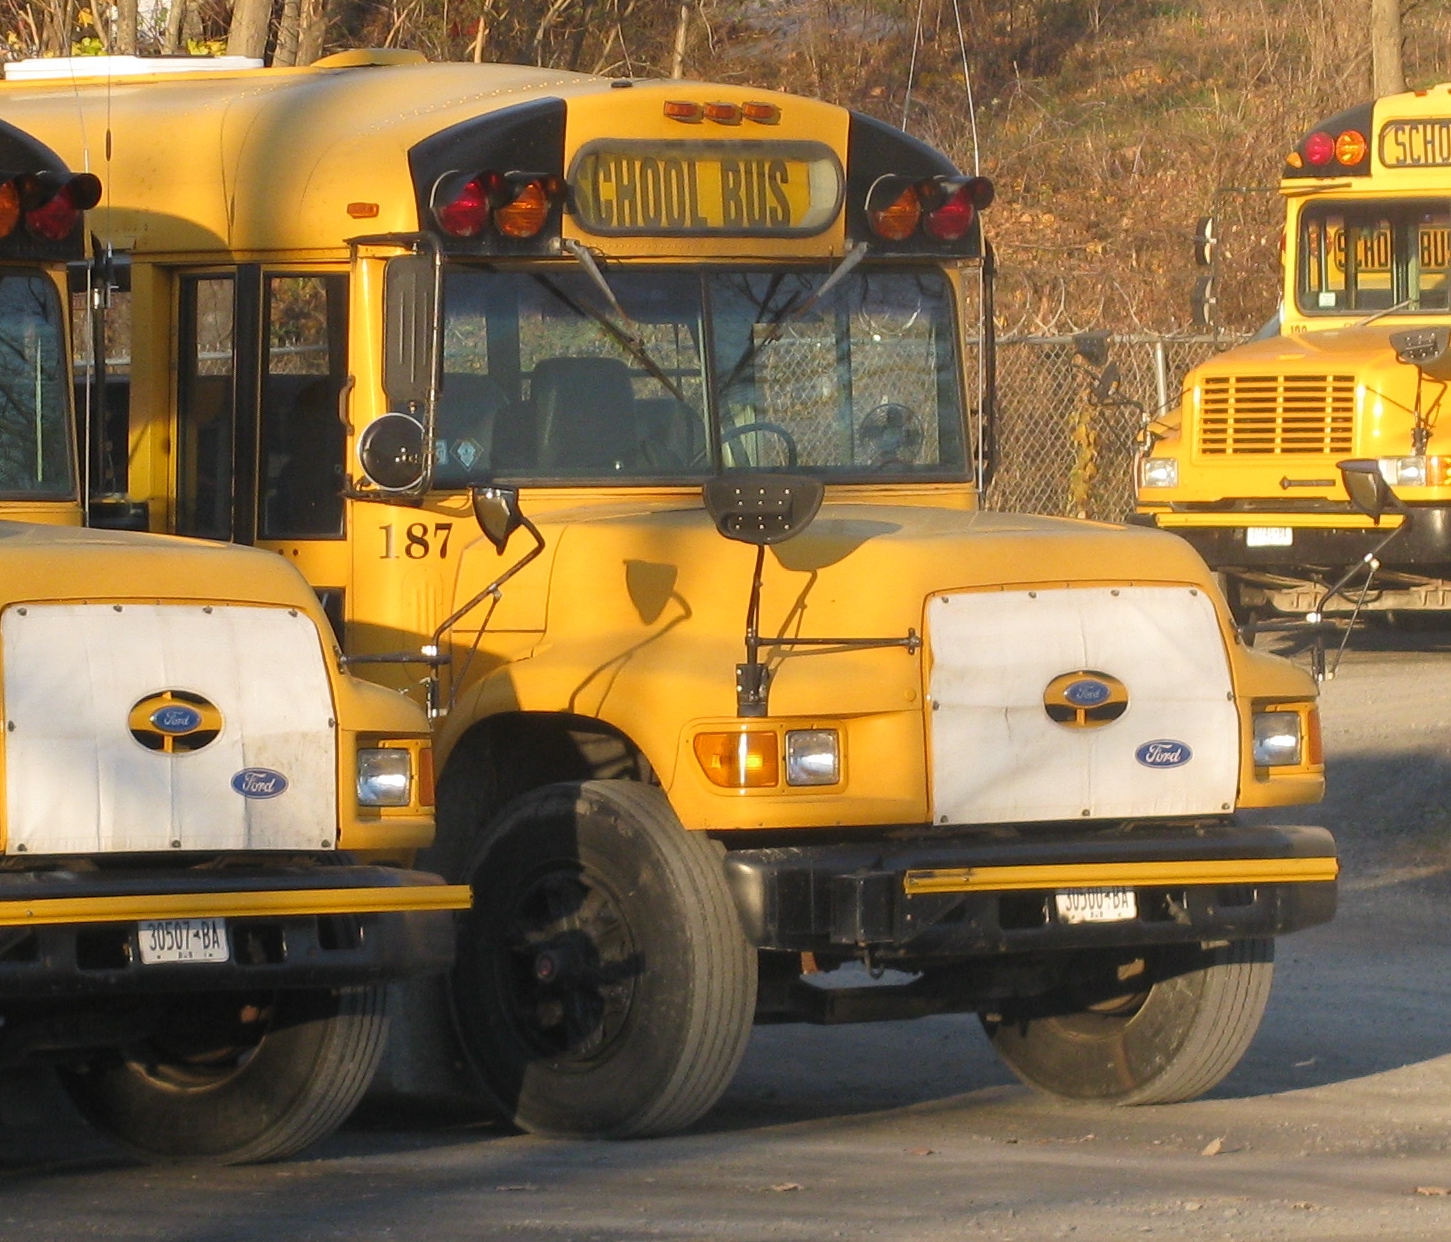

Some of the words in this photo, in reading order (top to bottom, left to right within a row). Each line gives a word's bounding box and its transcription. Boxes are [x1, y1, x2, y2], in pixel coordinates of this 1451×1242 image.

[720, 156, 791, 228] BUS
[378, 522, 453, 560] 187
[1076, 684, 1100, 699] Ford
[163, 711, 191, 727] Ford
[1146, 743, 1182, 764] Ford
[242, 771, 276, 794] Ford
[149, 921, 191, 951] 30507
